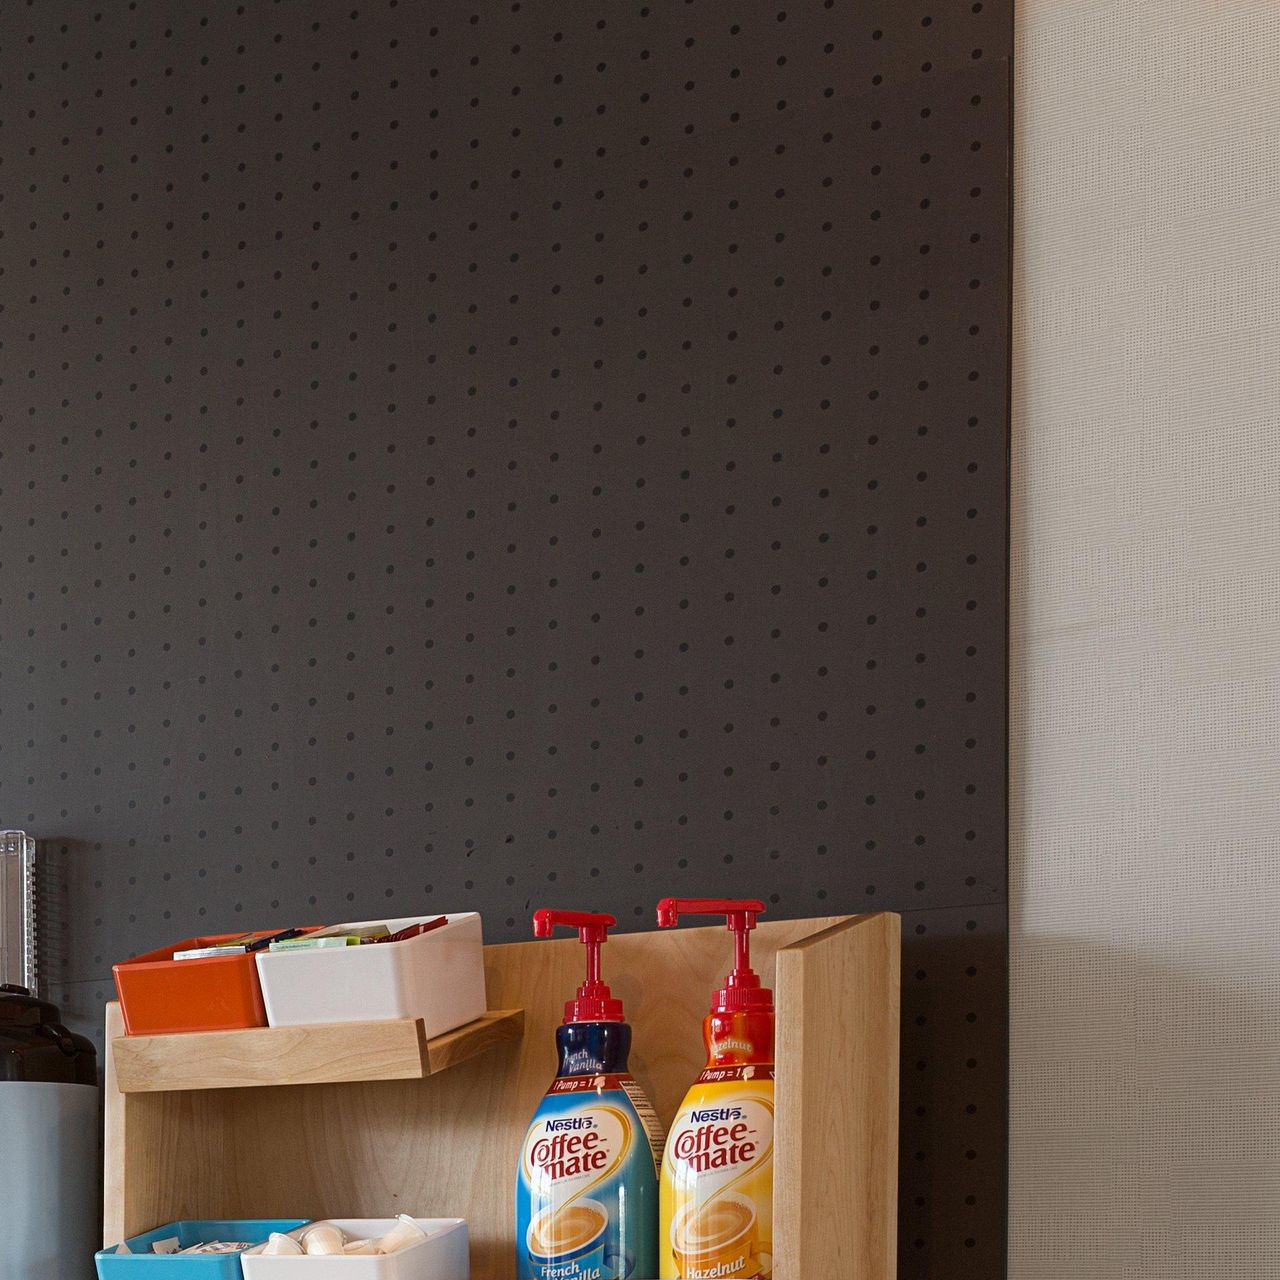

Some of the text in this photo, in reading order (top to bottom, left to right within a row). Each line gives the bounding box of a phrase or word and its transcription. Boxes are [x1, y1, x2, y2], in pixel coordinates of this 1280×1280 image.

[543, 1149, 608, 1181] mate
[688, 1141, 757, 1173] mate
[541, 1261, 581, 1278] French
[686, 1255, 746, 1279] Hazelnut
